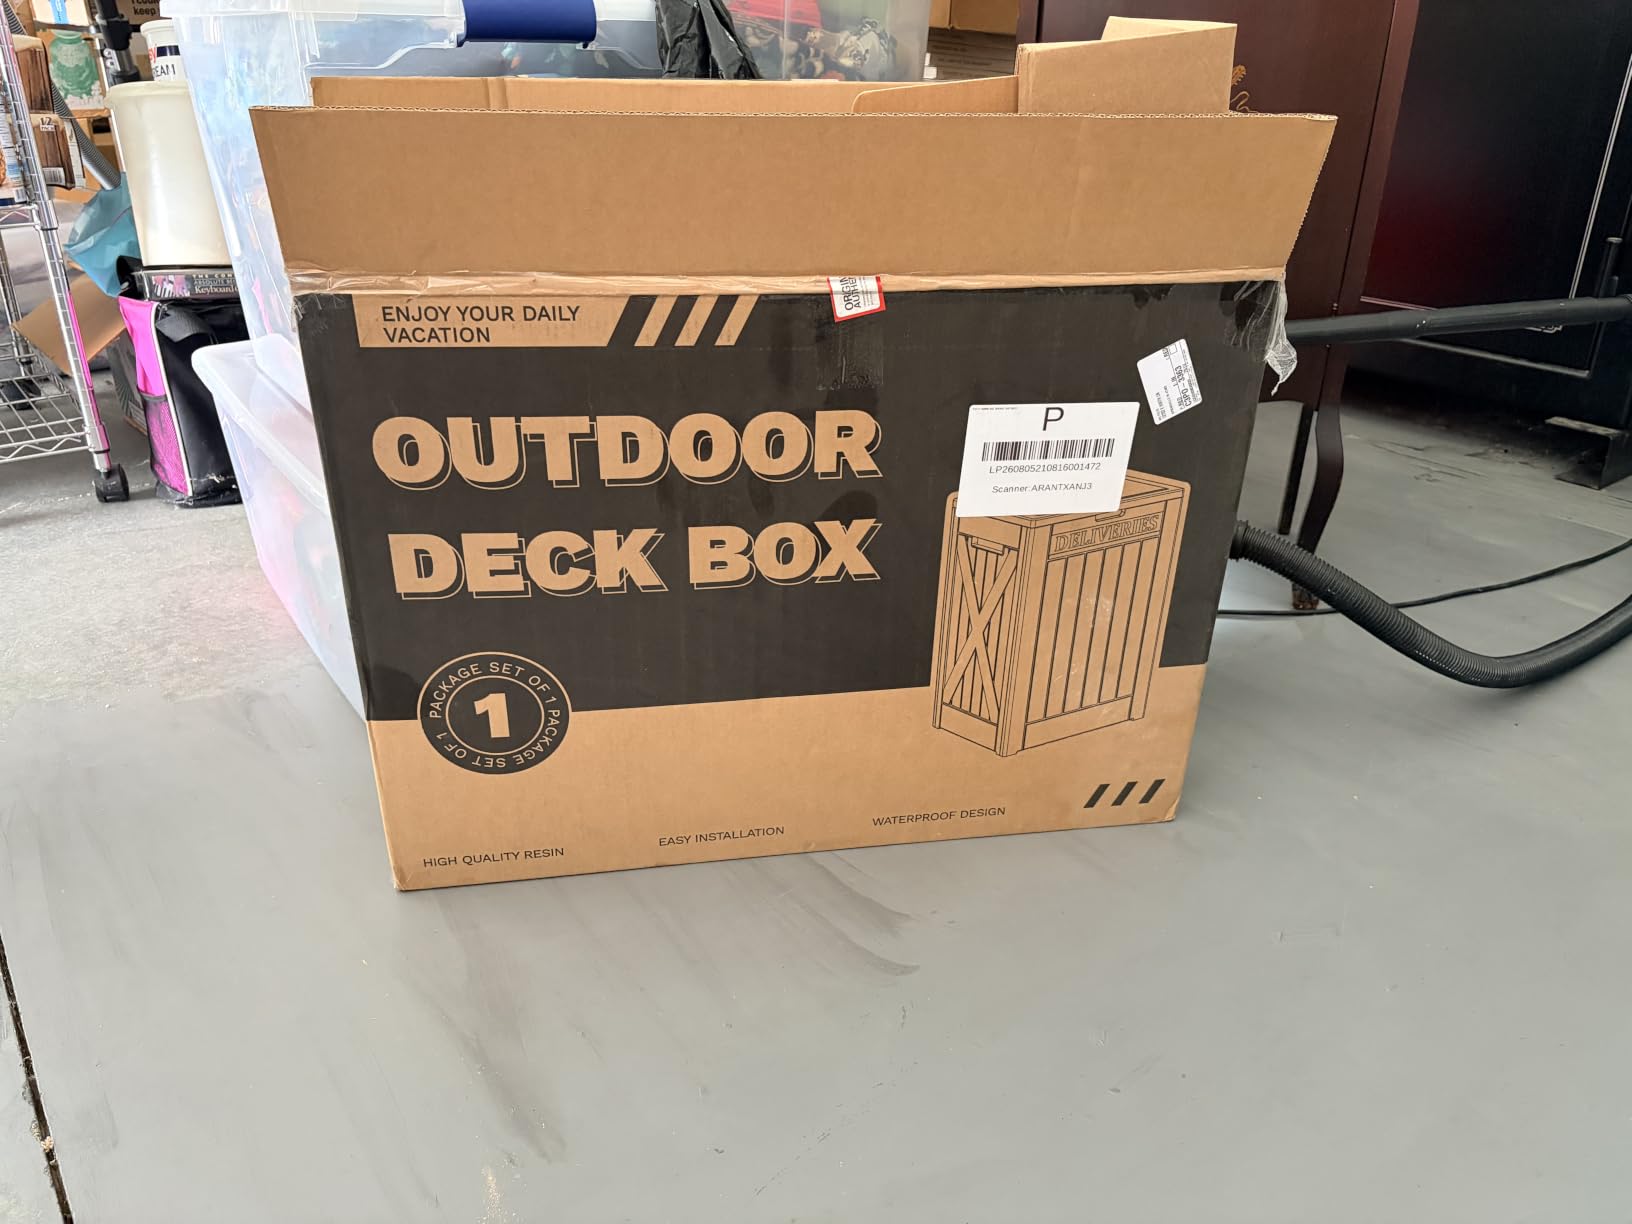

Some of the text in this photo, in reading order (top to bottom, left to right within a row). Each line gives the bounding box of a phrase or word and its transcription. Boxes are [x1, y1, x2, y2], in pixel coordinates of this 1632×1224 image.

[133, 6, 156, 16] keep
[195, 285, 234, 294] Keyboard
[382, 305, 580, 322] ENJOY YOUR DAILY
[383, 327, 490, 344] VACATION
[1042, 406, 1065, 431] P
[371, 409, 884, 491] OUTDOOR
[1054, 514, 1160, 552] DELIVERIES
[387, 518, 883, 600] DECK BOX
[429, 661, 557, 719] PACKAGE SET OF 1
[473, 692, 511, 739] 1
[436, 709, 561, 768] PACKAGE SET OF 1
[872, 807, 1006, 827] WATERPROOF DESIGN
[659, 827, 784, 847] EASY INSTALLATION
[422, 848, 565, 868] HIGH QUALITY RESIN
